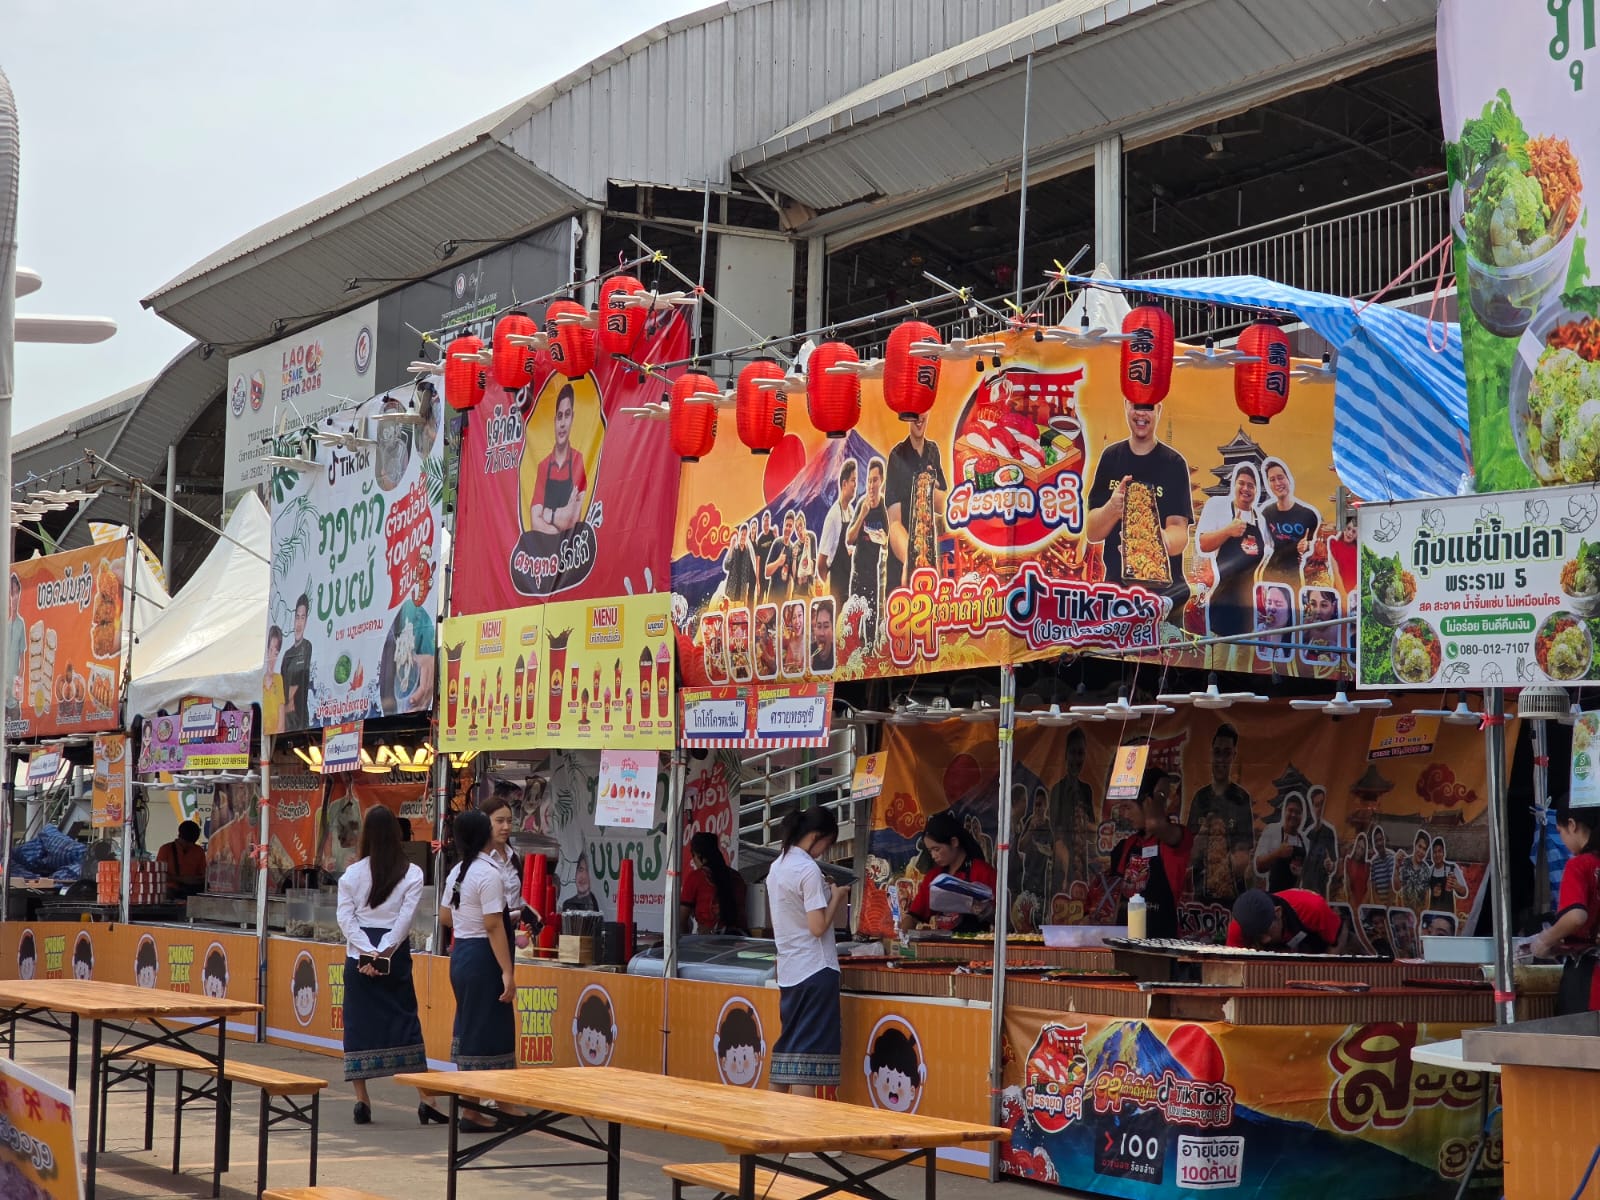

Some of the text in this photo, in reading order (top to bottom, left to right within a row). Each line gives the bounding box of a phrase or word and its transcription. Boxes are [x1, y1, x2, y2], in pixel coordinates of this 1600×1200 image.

[282, 346, 304, 371] LAO
[282, 384, 300, 401] EXPO
[340, 452, 369, 477] TikTok
[1413, 517, 1563, 576] กุ้งแช่น้ำปลา
[1446, 568, 1527, 592] พระราม 5
[1054, 589, 1155, 621] TikTok
[1419, 602, 1431, 612] สด
[1434, 600, 1460, 611] สะอาด
[1506, 593, 1560, 608] ไม่เหมือนใคร
[593, 607, 617, 628] MENU
[1447, 616, 1530, 633] ไม่อร่อย ยินดีคืนเงิน
[482, 620, 501, 640] MENU
[1460, 642, 1530, 656] 080-012-7107
[520, 1034, 553, 1064] FAIR
[1176, 1085, 1228, 1105] TikTok
[1119, 1132, 1159, 1160] 100
[1182, 1139, 1239, 1163] อายุน้อย
[1181, 1162, 1237, 1182] 100ล้าน
